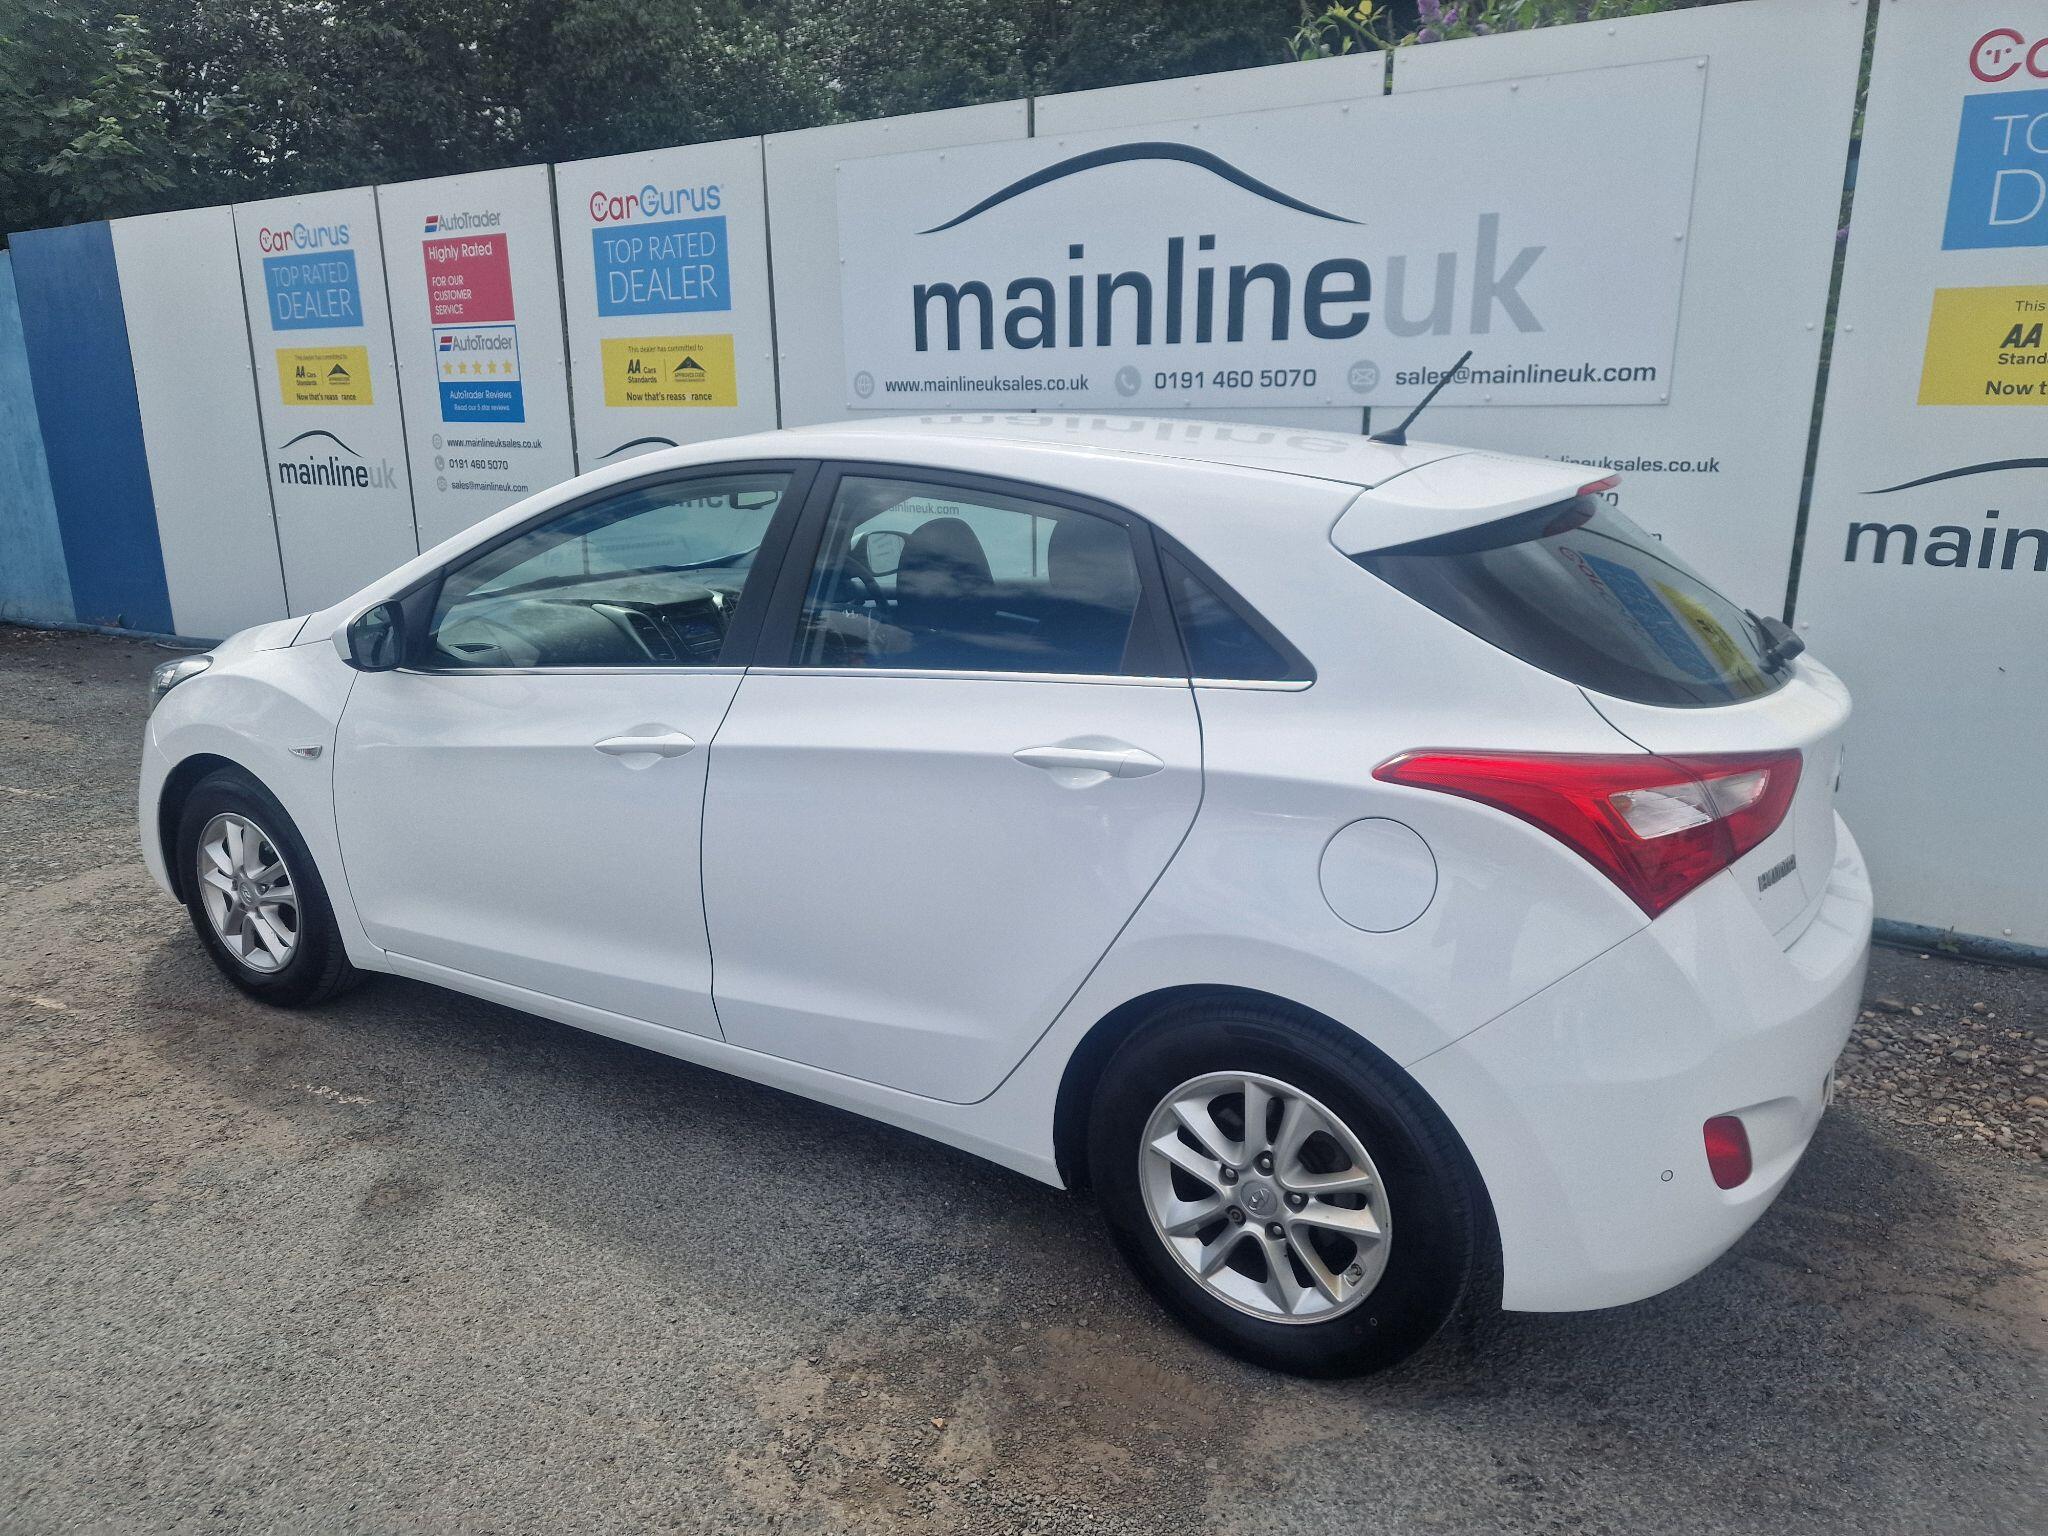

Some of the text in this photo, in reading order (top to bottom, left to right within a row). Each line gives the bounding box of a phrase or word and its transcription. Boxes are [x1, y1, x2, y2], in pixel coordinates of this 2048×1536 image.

[590, 184, 721, 222] CarGurus
[438, 210, 501, 231] AutoTrader
[259, 223, 350, 252] CarGurus
[428, 241, 493, 262] Highly Rated
[603, 231, 716, 264] TOP RATED
[271, 261, 349, 288] TOP RATED
[432, 274, 464, 287] FOR OUR
[608, 264, 718, 304] DEALER
[433, 288, 472, 301] CUSTOMER
[276, 288, 354, 320] DEALER
[435, 304, 464, 316] SERVICE
[2015, 300, 2047, 312] This
[452, 334, 513, 351] AutoTrader
[1999, 322, 2044, 349] AA
[1997, 352, 2048, 365] Stand
[295, 365, 305, 379] AA
[627, 359, 641, 374] AA
[885, 374, 1089, 393] www.mainlineuksales.co.uk
[1154, 369, 1317, 390] 0191 460 5070
[485, 389, 512, 400] Reviews
[1985, 380, 2034, 396] Now
[296, 392, 308, 401] Now
[626, 391, 643, 401] Now
[644, 391, 665, 401] that's
[447, 437, 542, 449] www.mainlineuksales.co.uk
[449, 458, 509, 470] 0191 460 5070
[888, 501, 960, 515] ainlineuk.com
